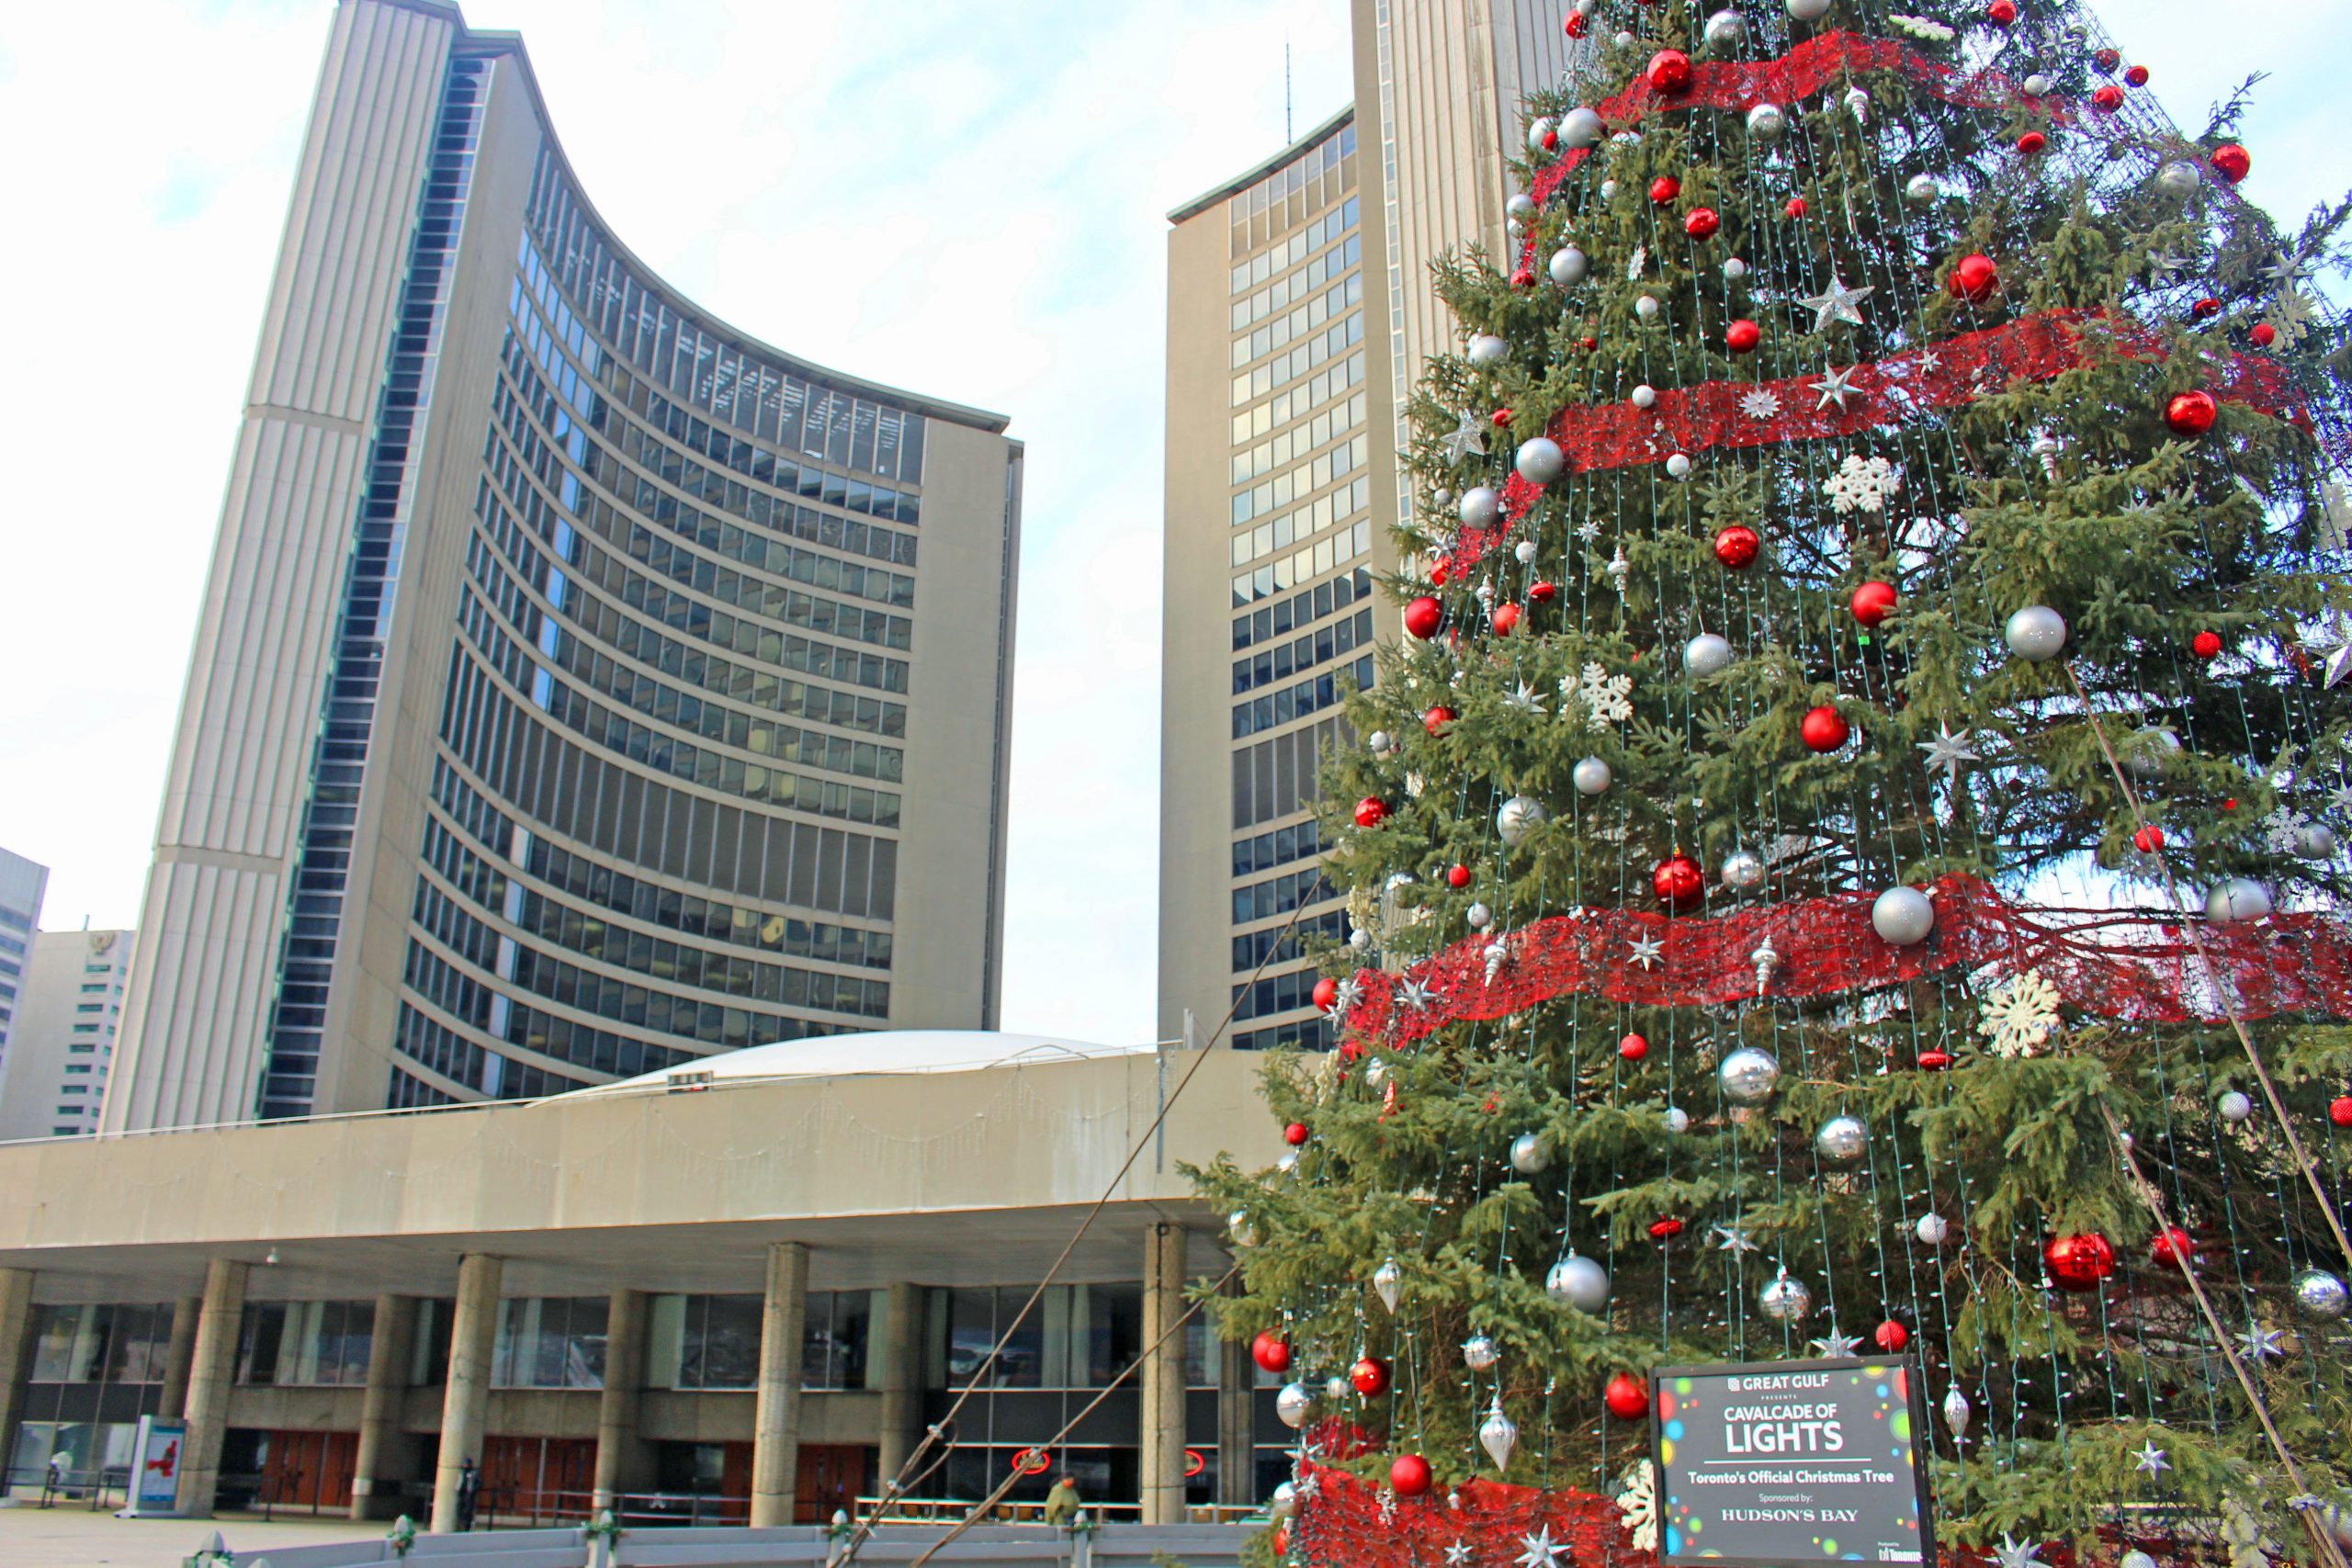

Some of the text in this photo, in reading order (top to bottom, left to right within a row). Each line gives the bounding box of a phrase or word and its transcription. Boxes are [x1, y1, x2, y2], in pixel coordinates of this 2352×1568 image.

[1743, 1373, 1829, 1390] GREAT GULF
[1724, 1404, 1837, 1421] CAVALCADE OF
[1725, 1420, 1843, 1452] LIGHTS
[1688, 1469, 1894, 1484] Toronto's Official Christmas Tree
[1758, 1493, 1814, 1504] Sponsored by:
[1722, 1508, 1859, 1522] HUDSON'S BAY
